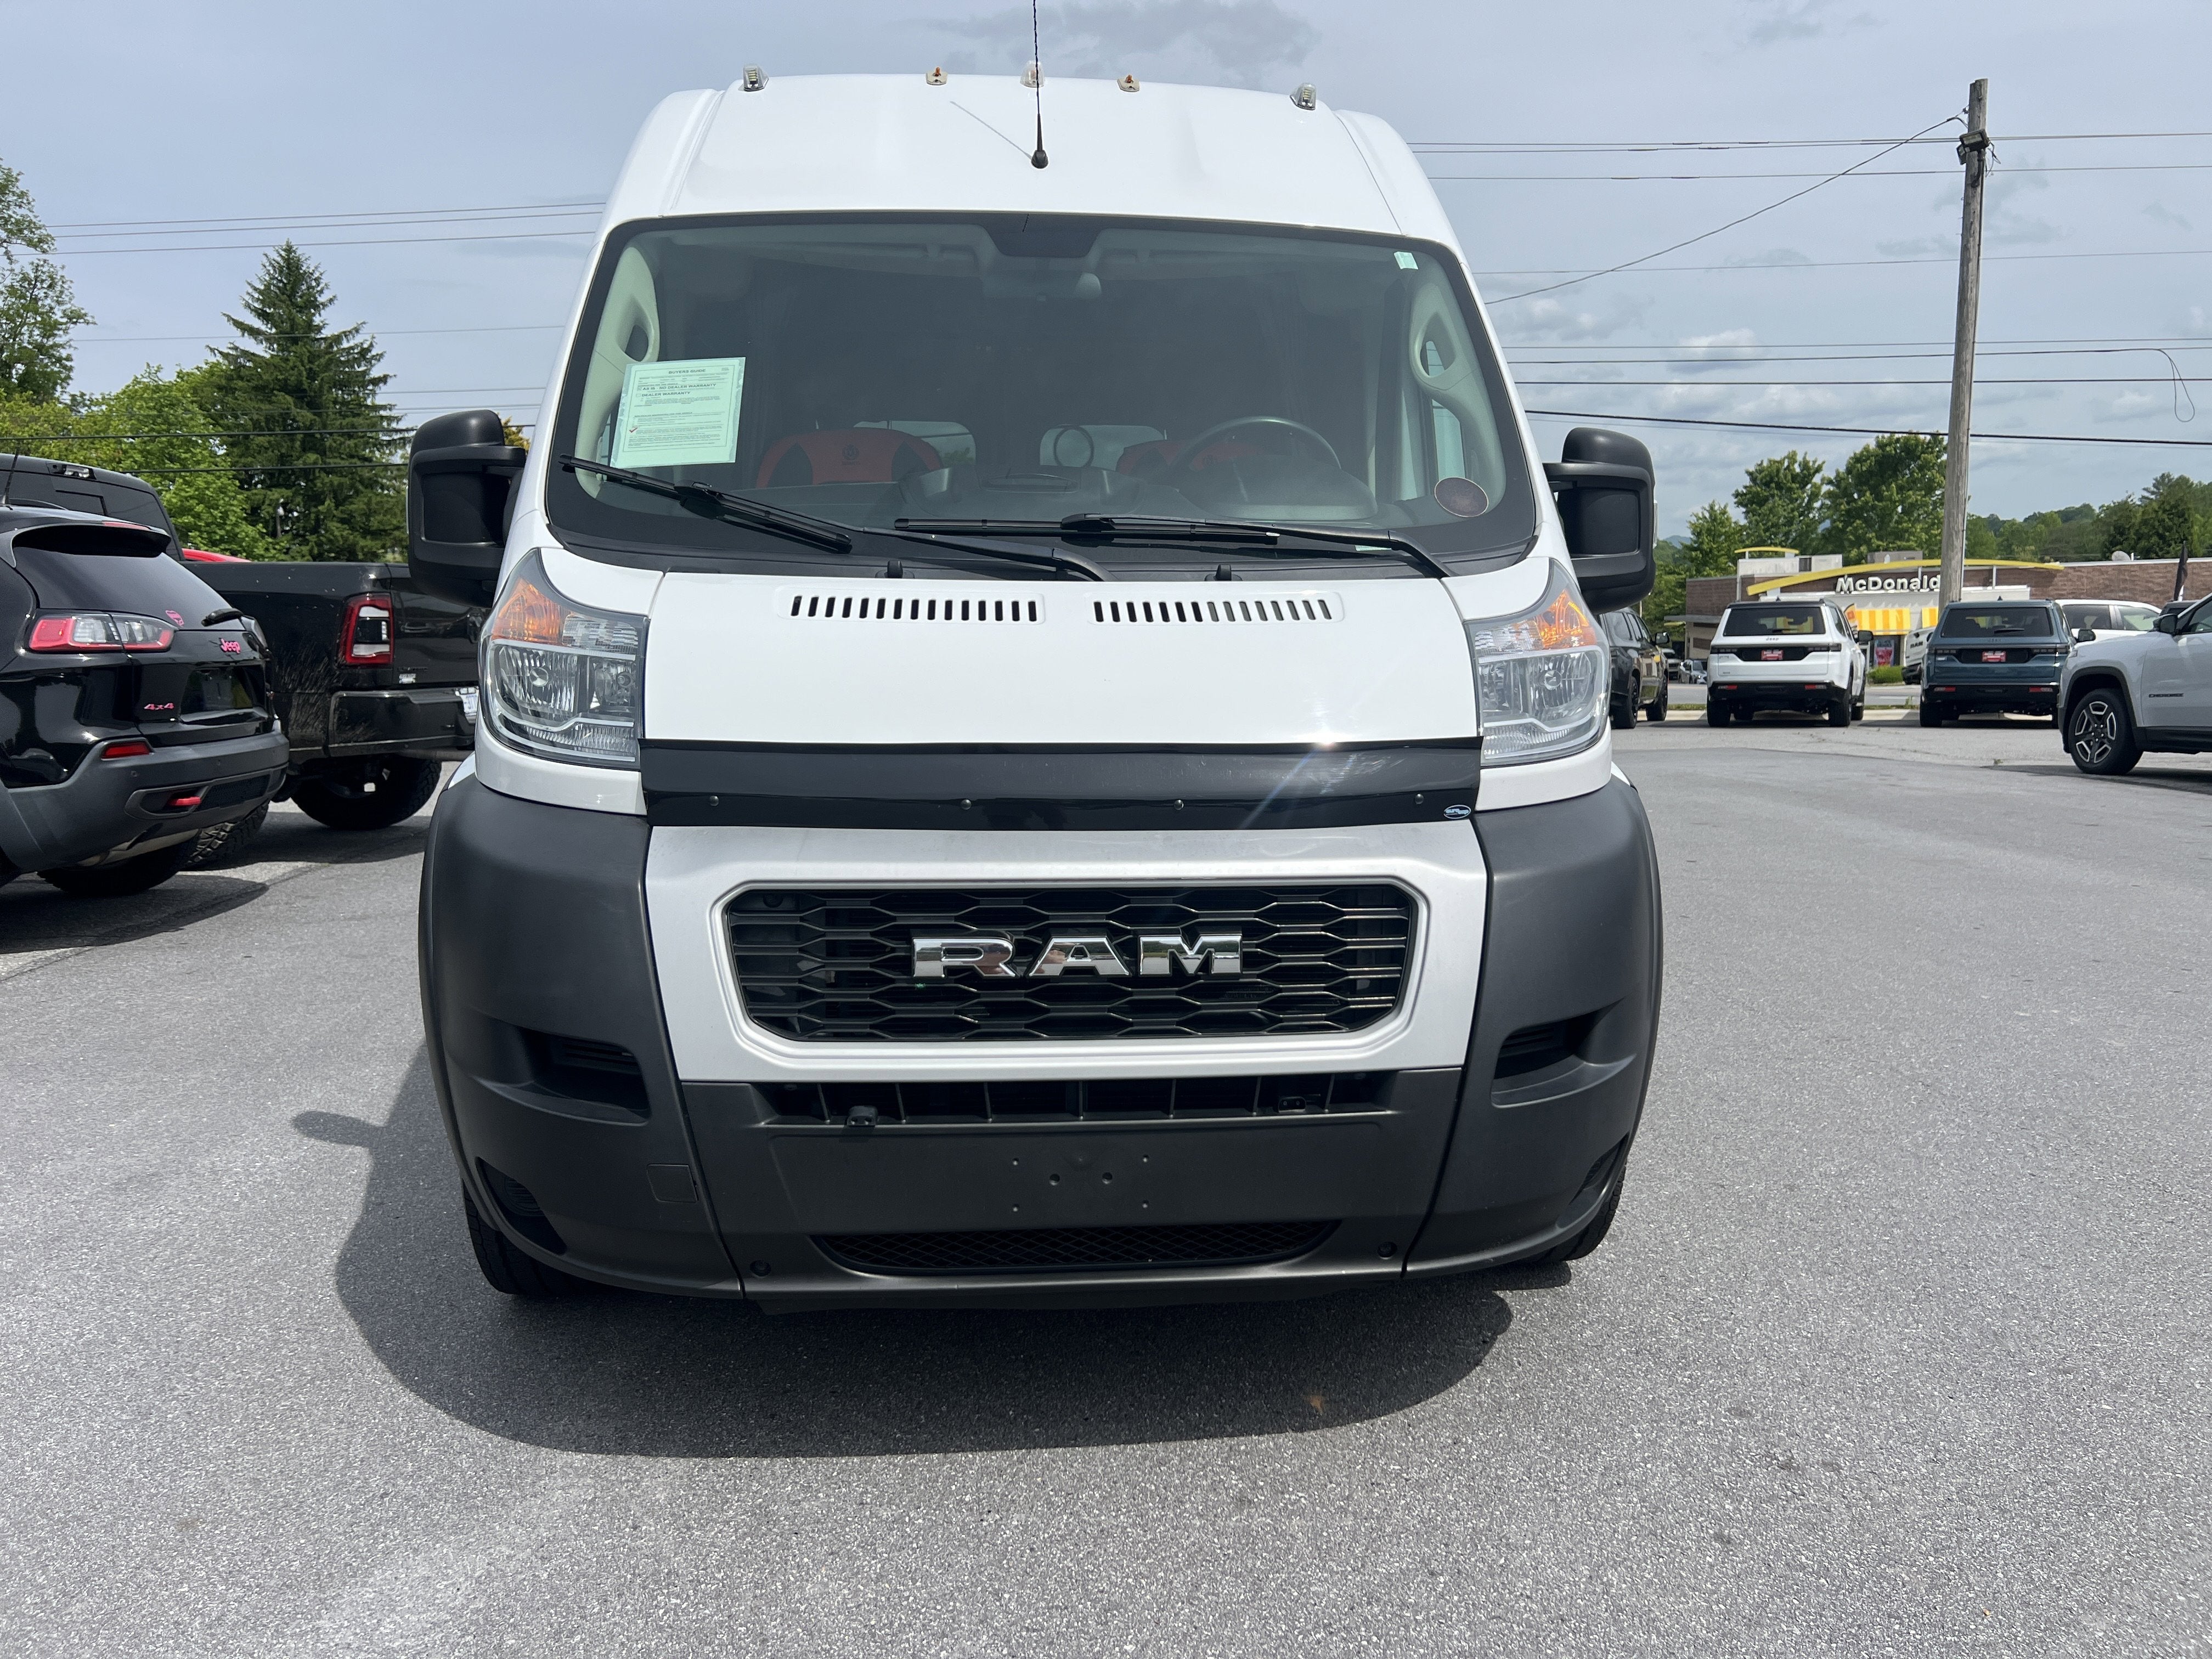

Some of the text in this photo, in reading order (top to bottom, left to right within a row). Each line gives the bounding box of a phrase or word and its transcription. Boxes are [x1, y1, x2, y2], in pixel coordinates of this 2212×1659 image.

[220, 638, 241, 654] Jeep
[144, 702, 175, 710] 4x4
[912, 935, 1243, 978] RAM
